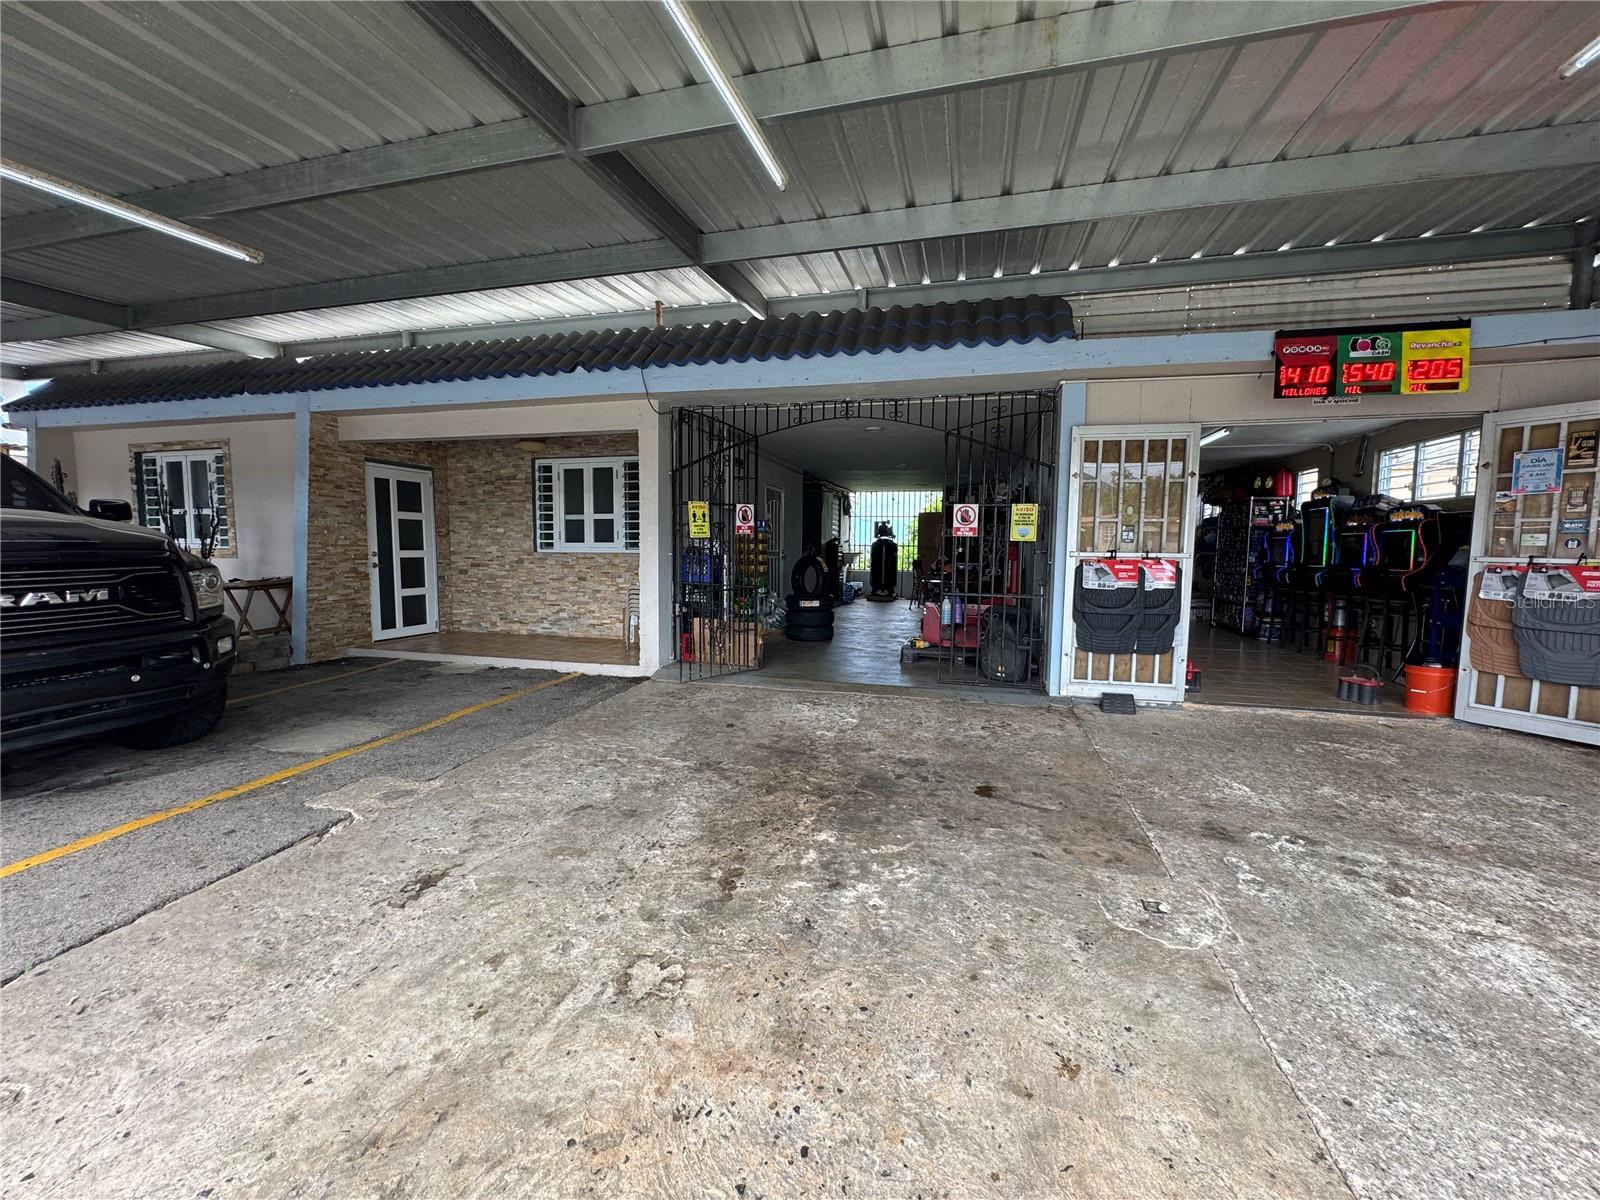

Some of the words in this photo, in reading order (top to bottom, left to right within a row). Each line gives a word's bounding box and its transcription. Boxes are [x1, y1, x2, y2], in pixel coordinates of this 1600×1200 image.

[1410, 341, 1452, 350] Revancha
[1348, 362, 1395, 382] 540
[1413, 359, 1462, 379] 205
[1287, 365, 1332, 384] 410
[1281, 387, 1328, 397] MILLONES
[1344, 386, 1362, 394] MIL
[1409, 383, 1428, 392] MIL
